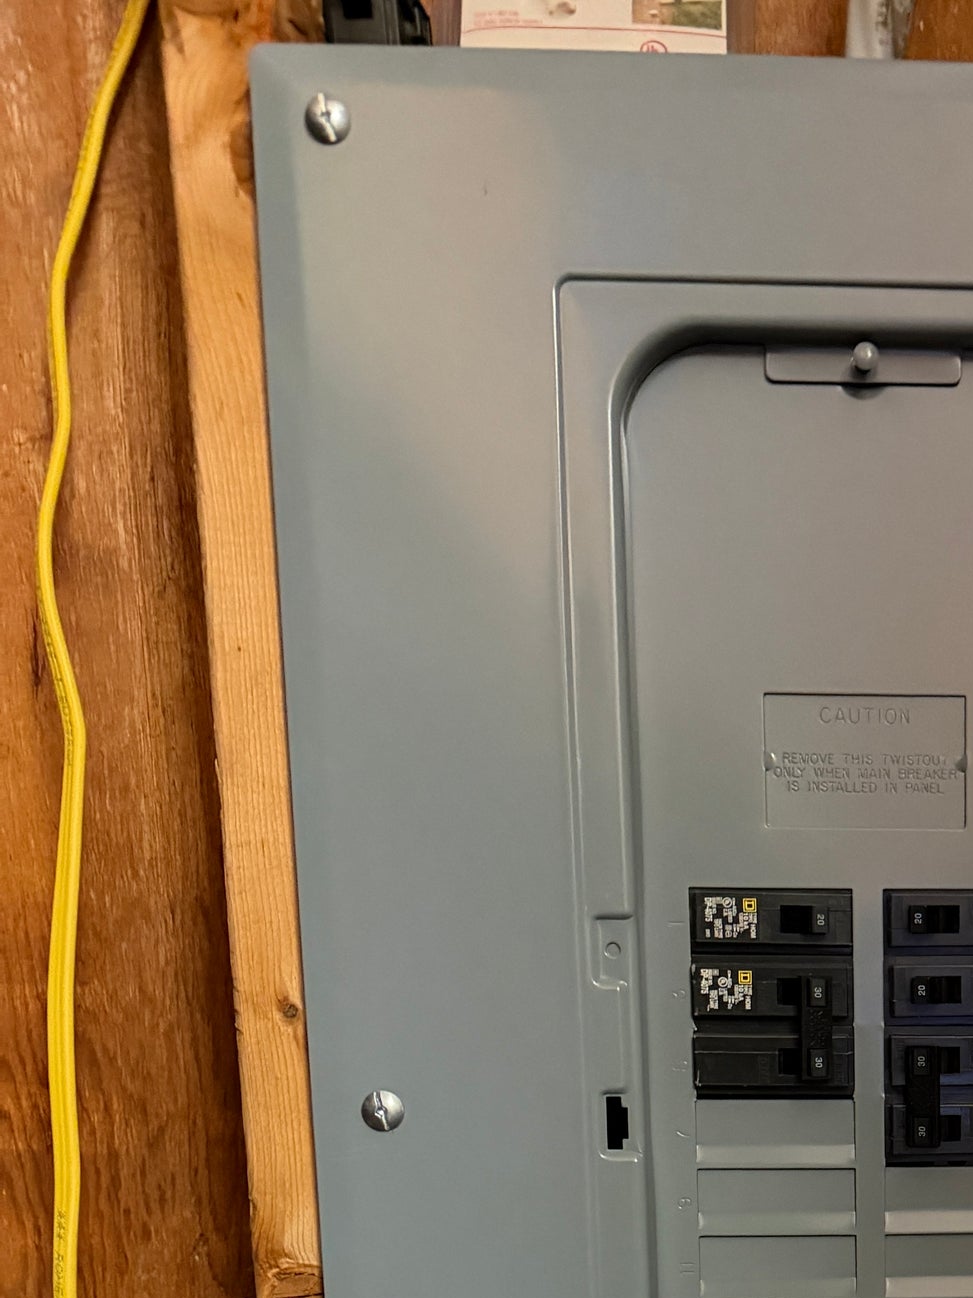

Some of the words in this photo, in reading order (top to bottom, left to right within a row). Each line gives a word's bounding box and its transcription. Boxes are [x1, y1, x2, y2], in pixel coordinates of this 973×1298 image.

[820, 706, 911, 725] CAUTION
[782, 752, 834, 765] REMOVE
[845, 753, 874, 765] THIS
[773, 766, 806, 778] ONLY
[814, 767, 850, 779] WHEN
[858, 768, 891, 779] MAIN
[898, 769, 958, 780] BREAKER
[787, 781, 800, 792] IS
[808, 781, 877, 793] INSTALLED
[885, 782, 897, 793] IN
[905, 782, 944, 794] PANEL
[817, 914, 824, 926] 20
[914, 913, 922, 925] 20
[814, 987, 822, 998] 30
[918, 985, 925, 996] 20
[815, 1057, 823, 1068] 30
[917, 1056, 925, 1067] 30
[918, 1126, 926, 1137] 30
